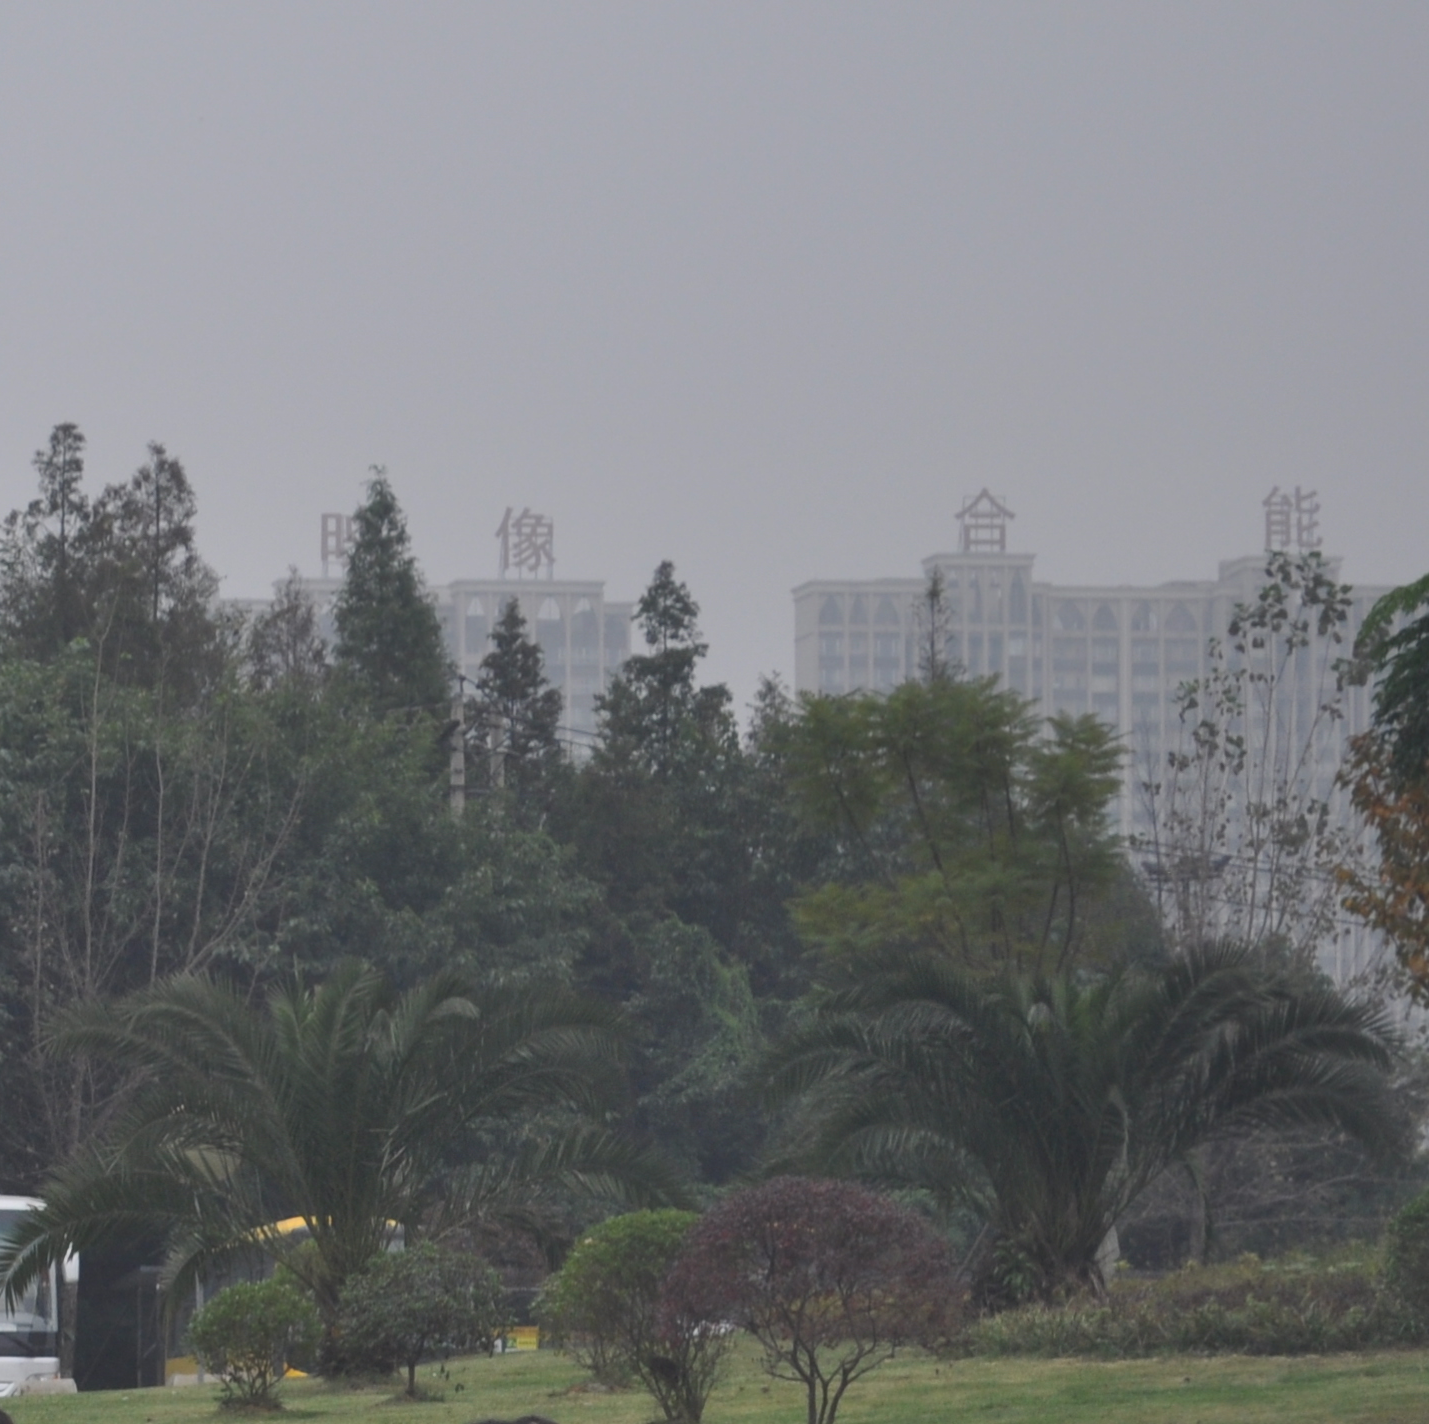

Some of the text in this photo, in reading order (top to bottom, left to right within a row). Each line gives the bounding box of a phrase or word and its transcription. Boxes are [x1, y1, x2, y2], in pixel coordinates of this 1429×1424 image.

[494, 505, 555, 573] 像
[954, 485, 1323, 552] 合 能
